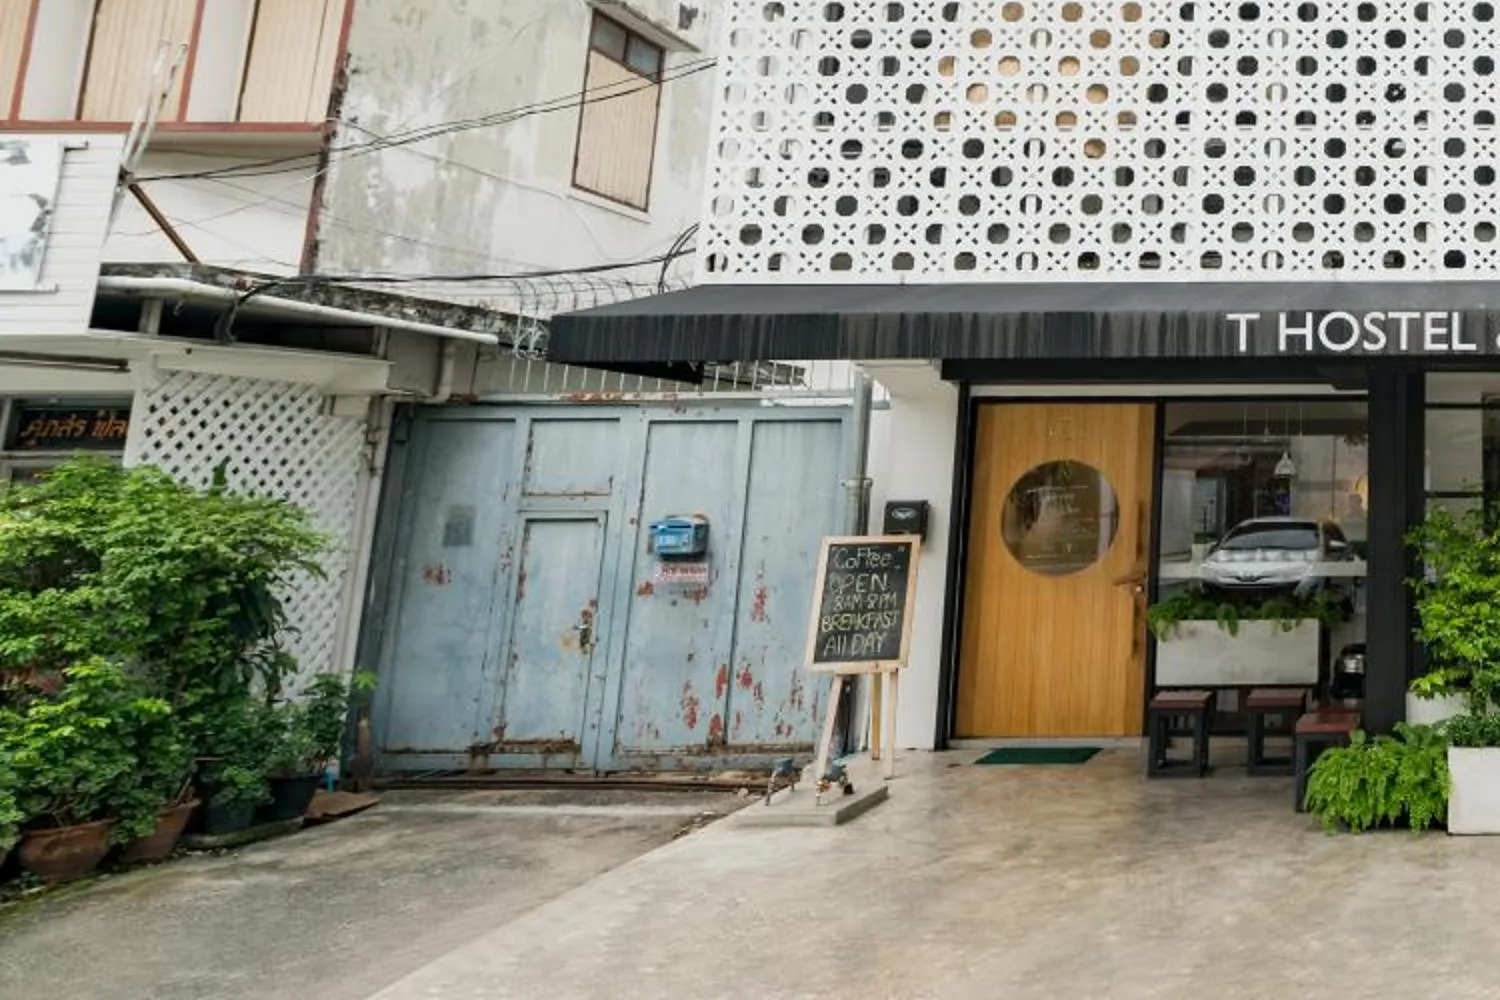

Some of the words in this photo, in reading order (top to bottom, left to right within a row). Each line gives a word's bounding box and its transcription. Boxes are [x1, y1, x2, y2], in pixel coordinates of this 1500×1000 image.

[1225, 311, 1261, 353] T
[1278, 311, 1478, 353] HOSTEL
[829, 572, 888, 596] OPEN
[851, 631, 888, 657] DAY
